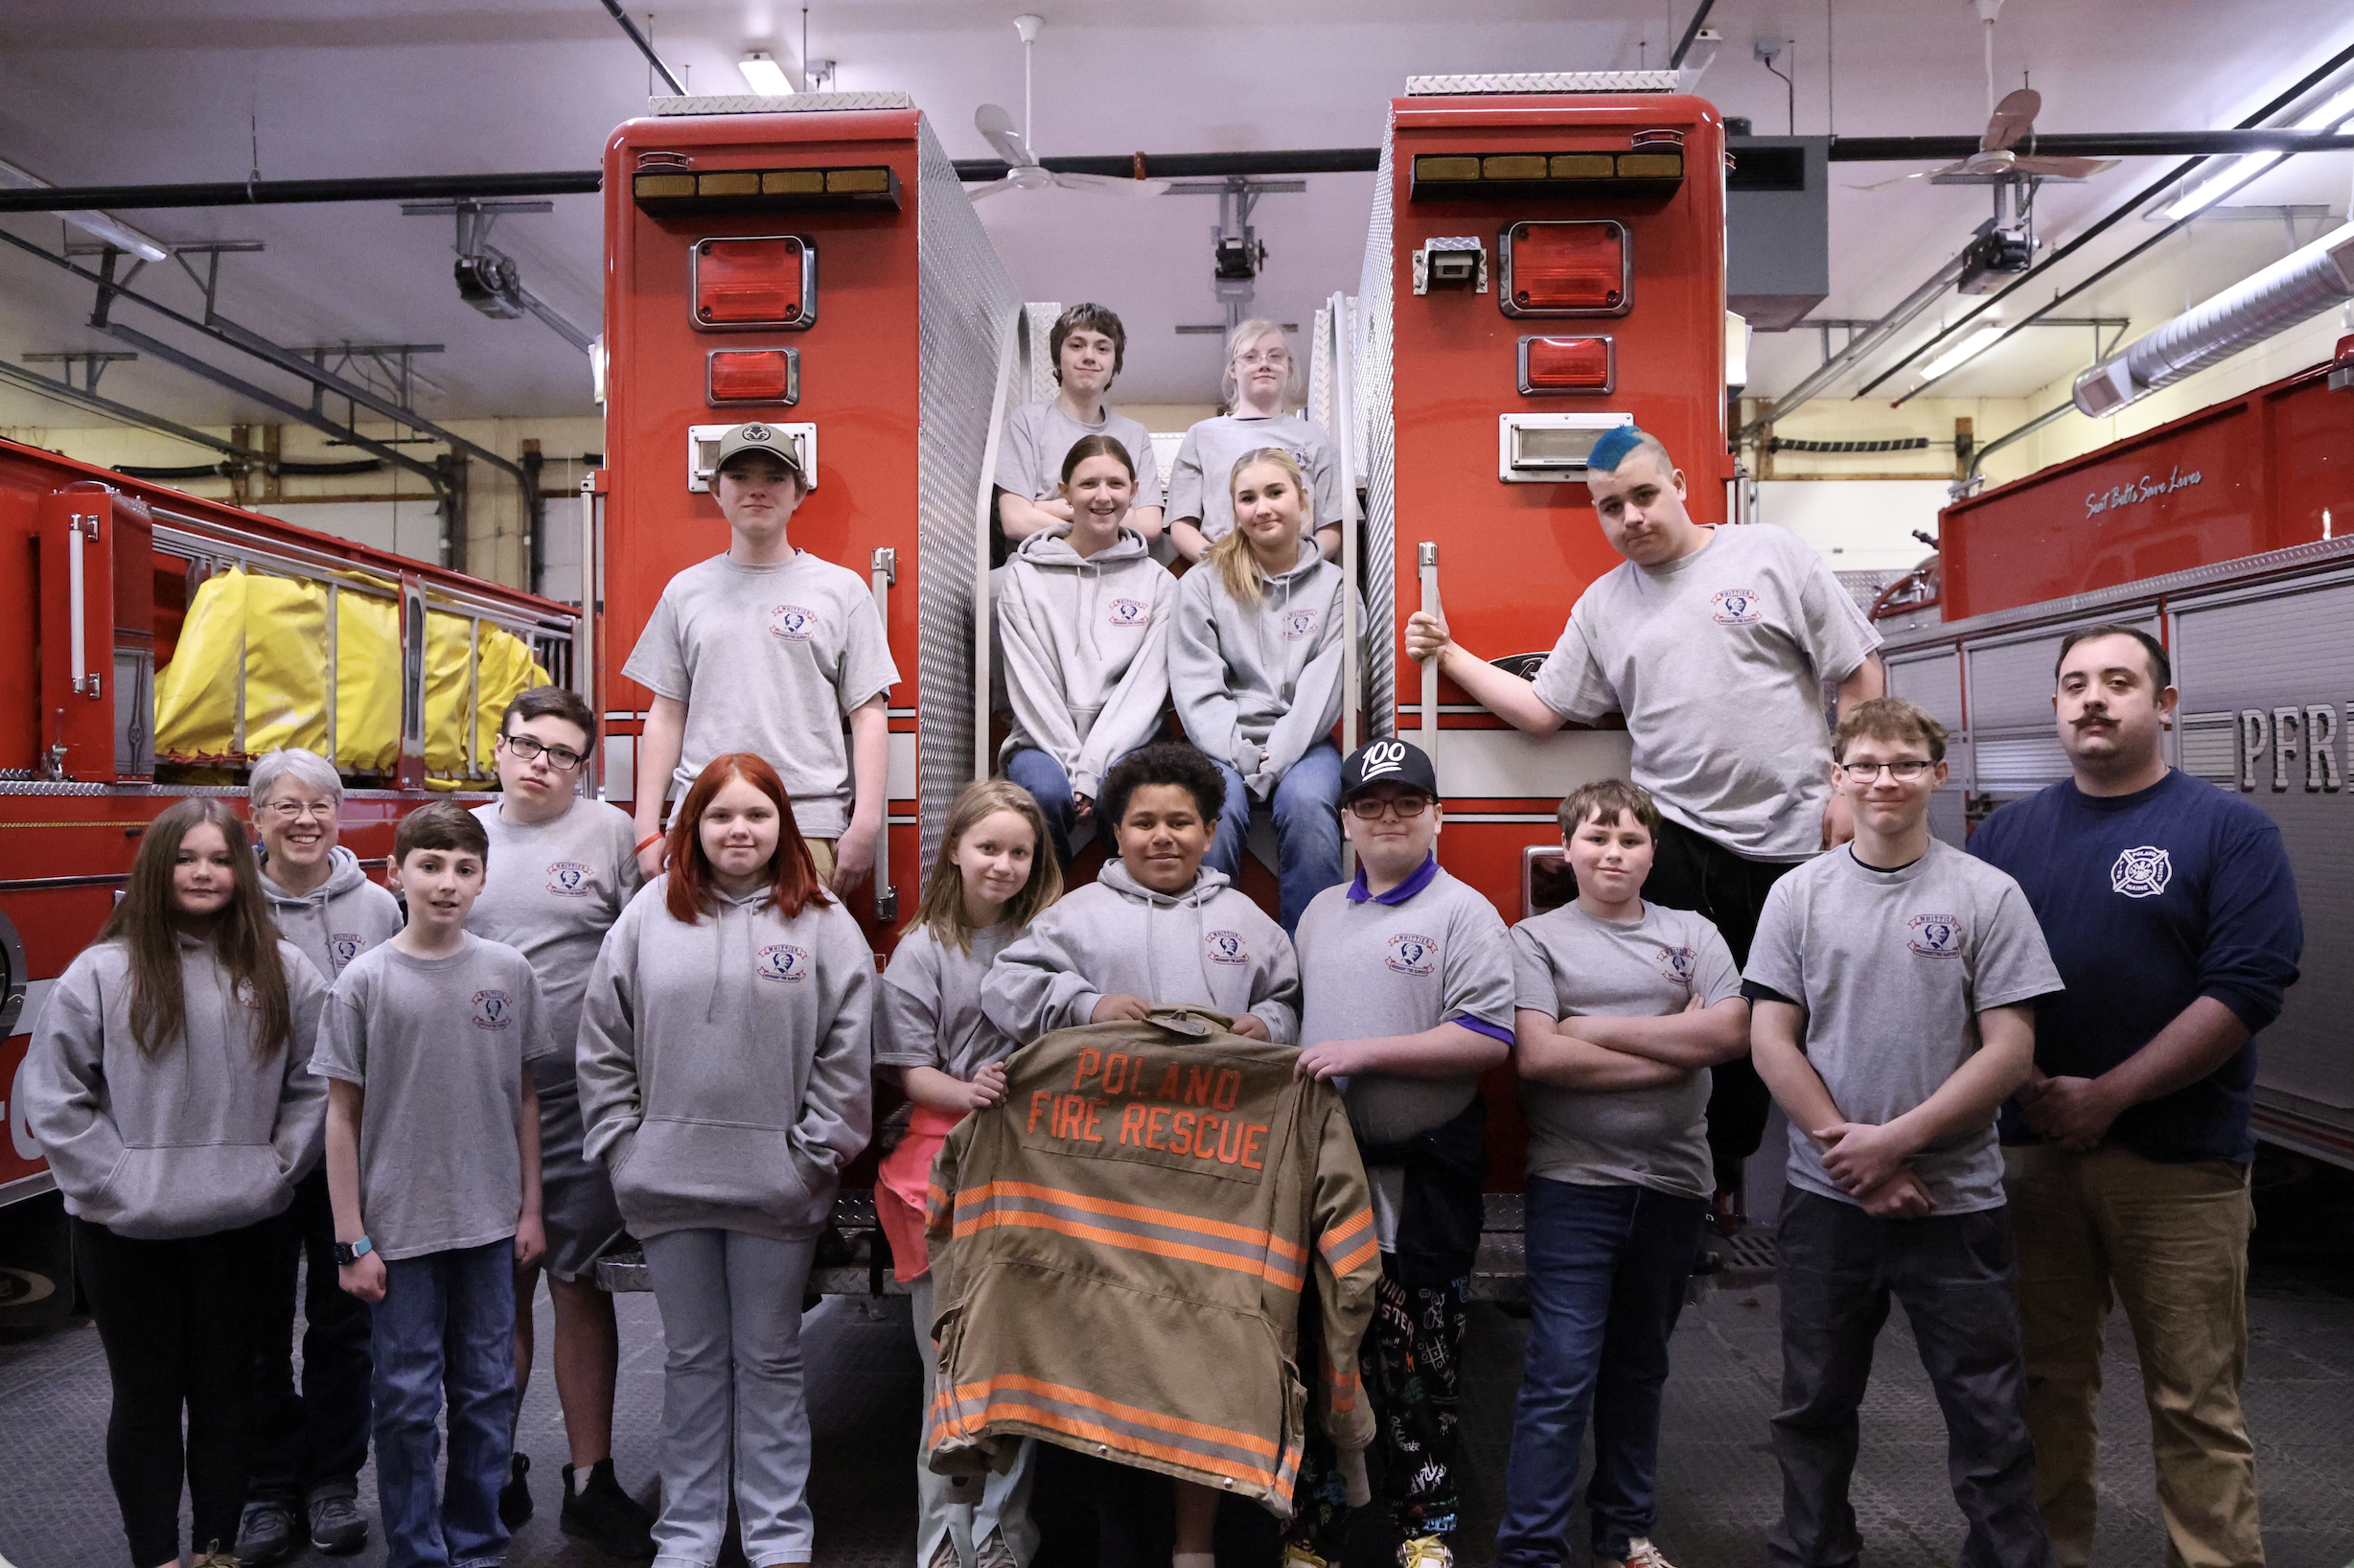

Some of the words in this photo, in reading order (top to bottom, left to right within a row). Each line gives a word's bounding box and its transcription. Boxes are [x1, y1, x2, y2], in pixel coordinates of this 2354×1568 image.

[2086, 493, 2110, 519] Seat
[2111, 482, 2138, 509] Belts
[2139, 474, 2167, 503] Save
[2168, 465, 2202, 493] Lives
[1361, 741, 1406, 777] 100
[2238, 703, 2342, 794] PFR
[1399, 935, 1430, 945] WHITTIER
[1073, 1047, 1242, 1113] POLAND
[1027, 1090, 1110, 1142] FIRE
[1119, 1102, 1269, 1170] RESCUE
